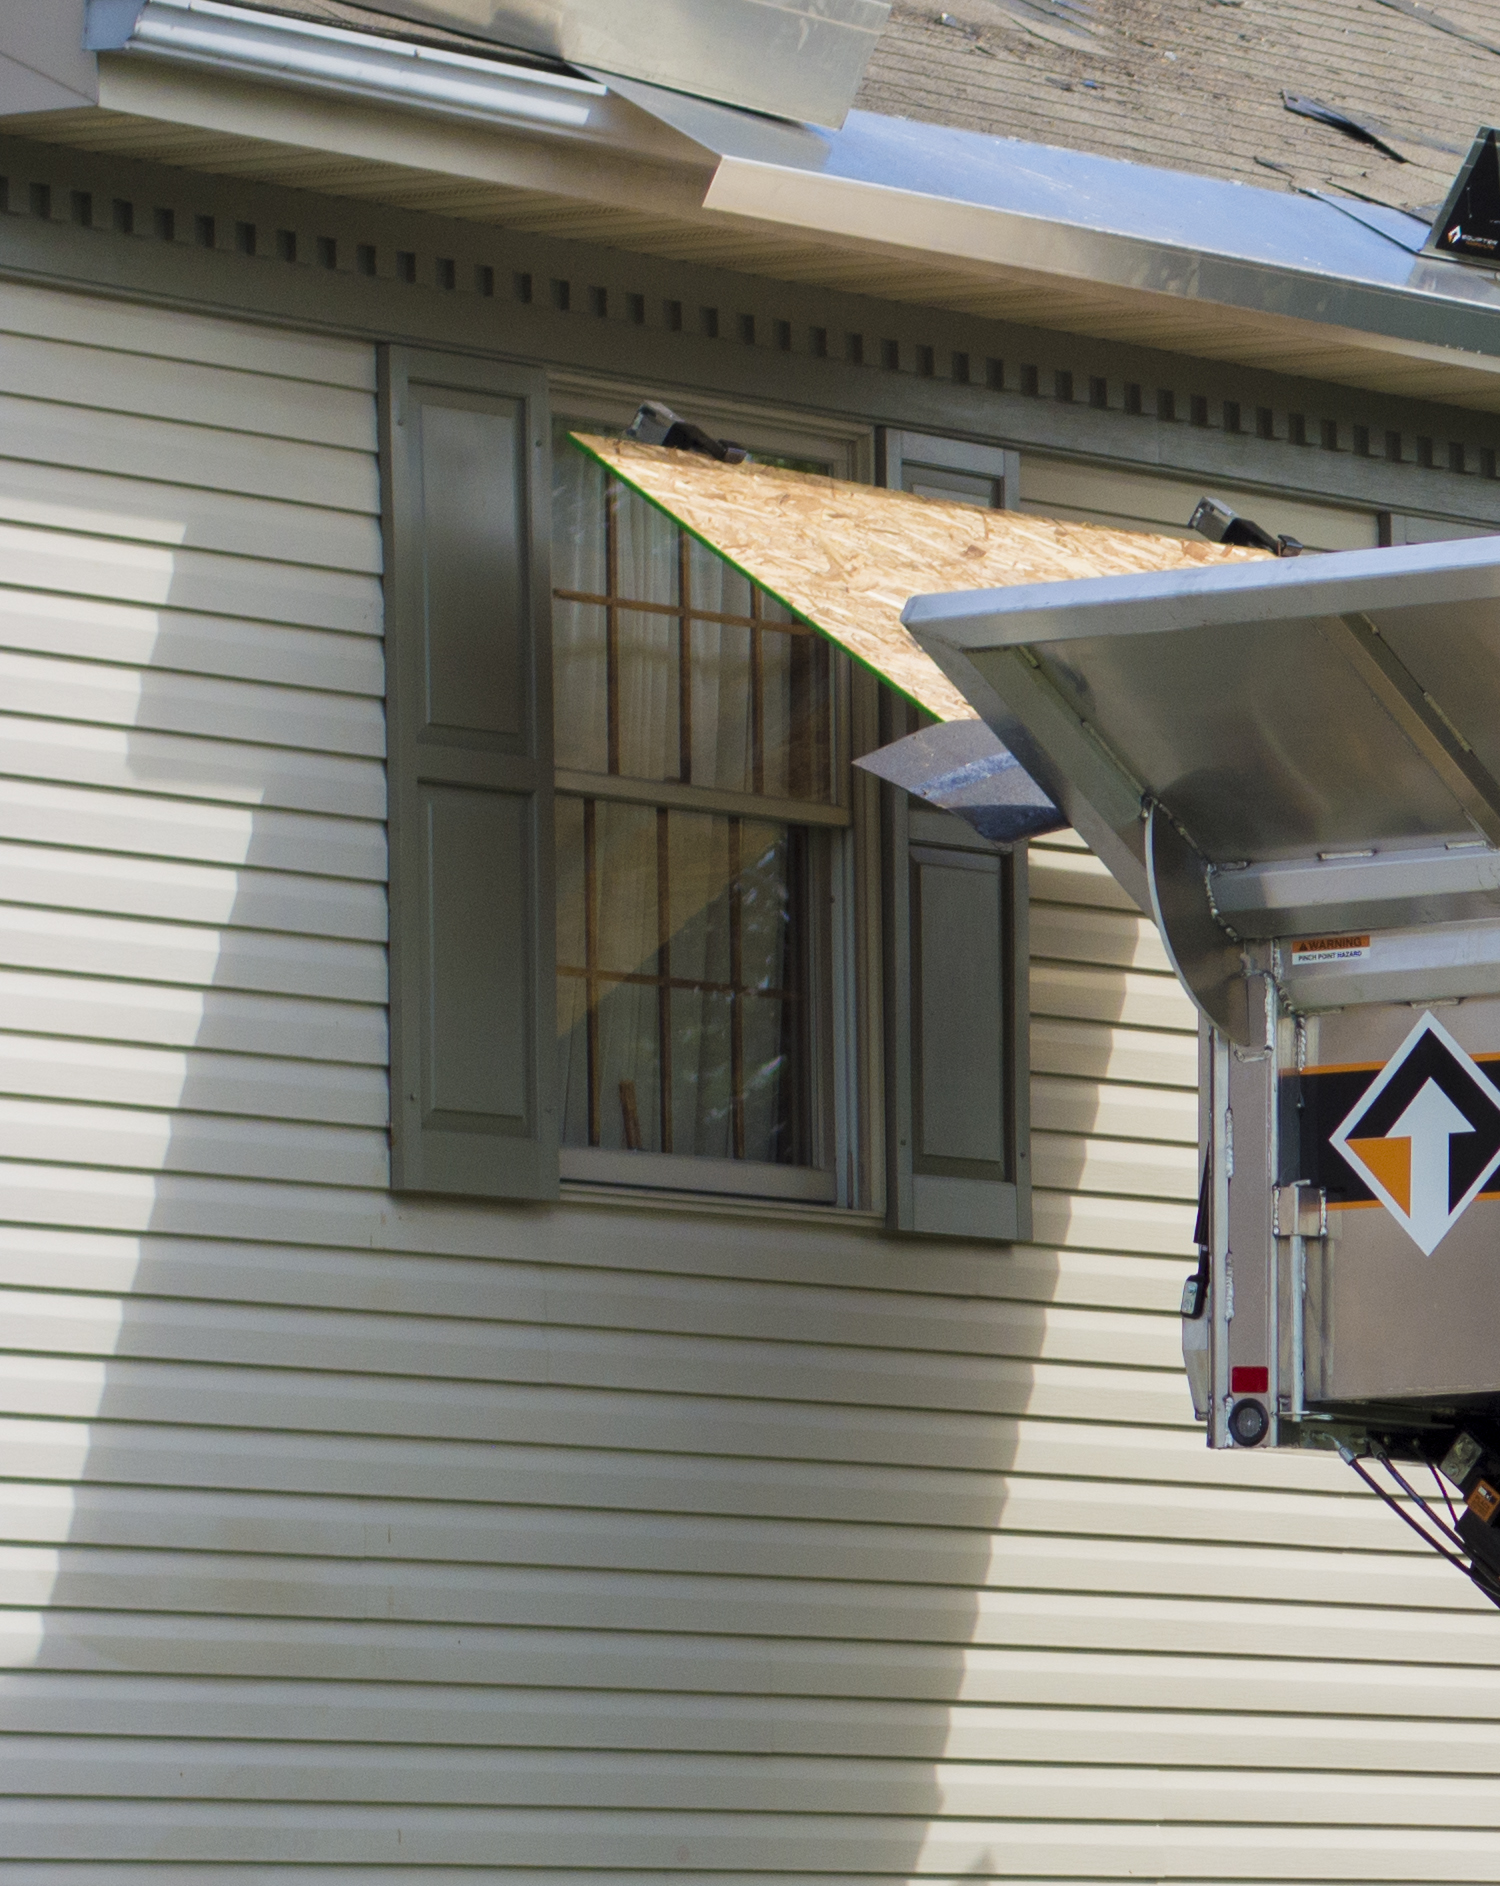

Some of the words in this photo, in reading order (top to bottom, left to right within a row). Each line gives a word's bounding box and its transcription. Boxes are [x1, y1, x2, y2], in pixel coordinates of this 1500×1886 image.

[1308, 937, 1362, 950] WARNING
[1298, 954, 1317, 962] PINCH
[1318, 952, 1336, 960] POINT
[1337, 950, 1362, 958] HAZARD
